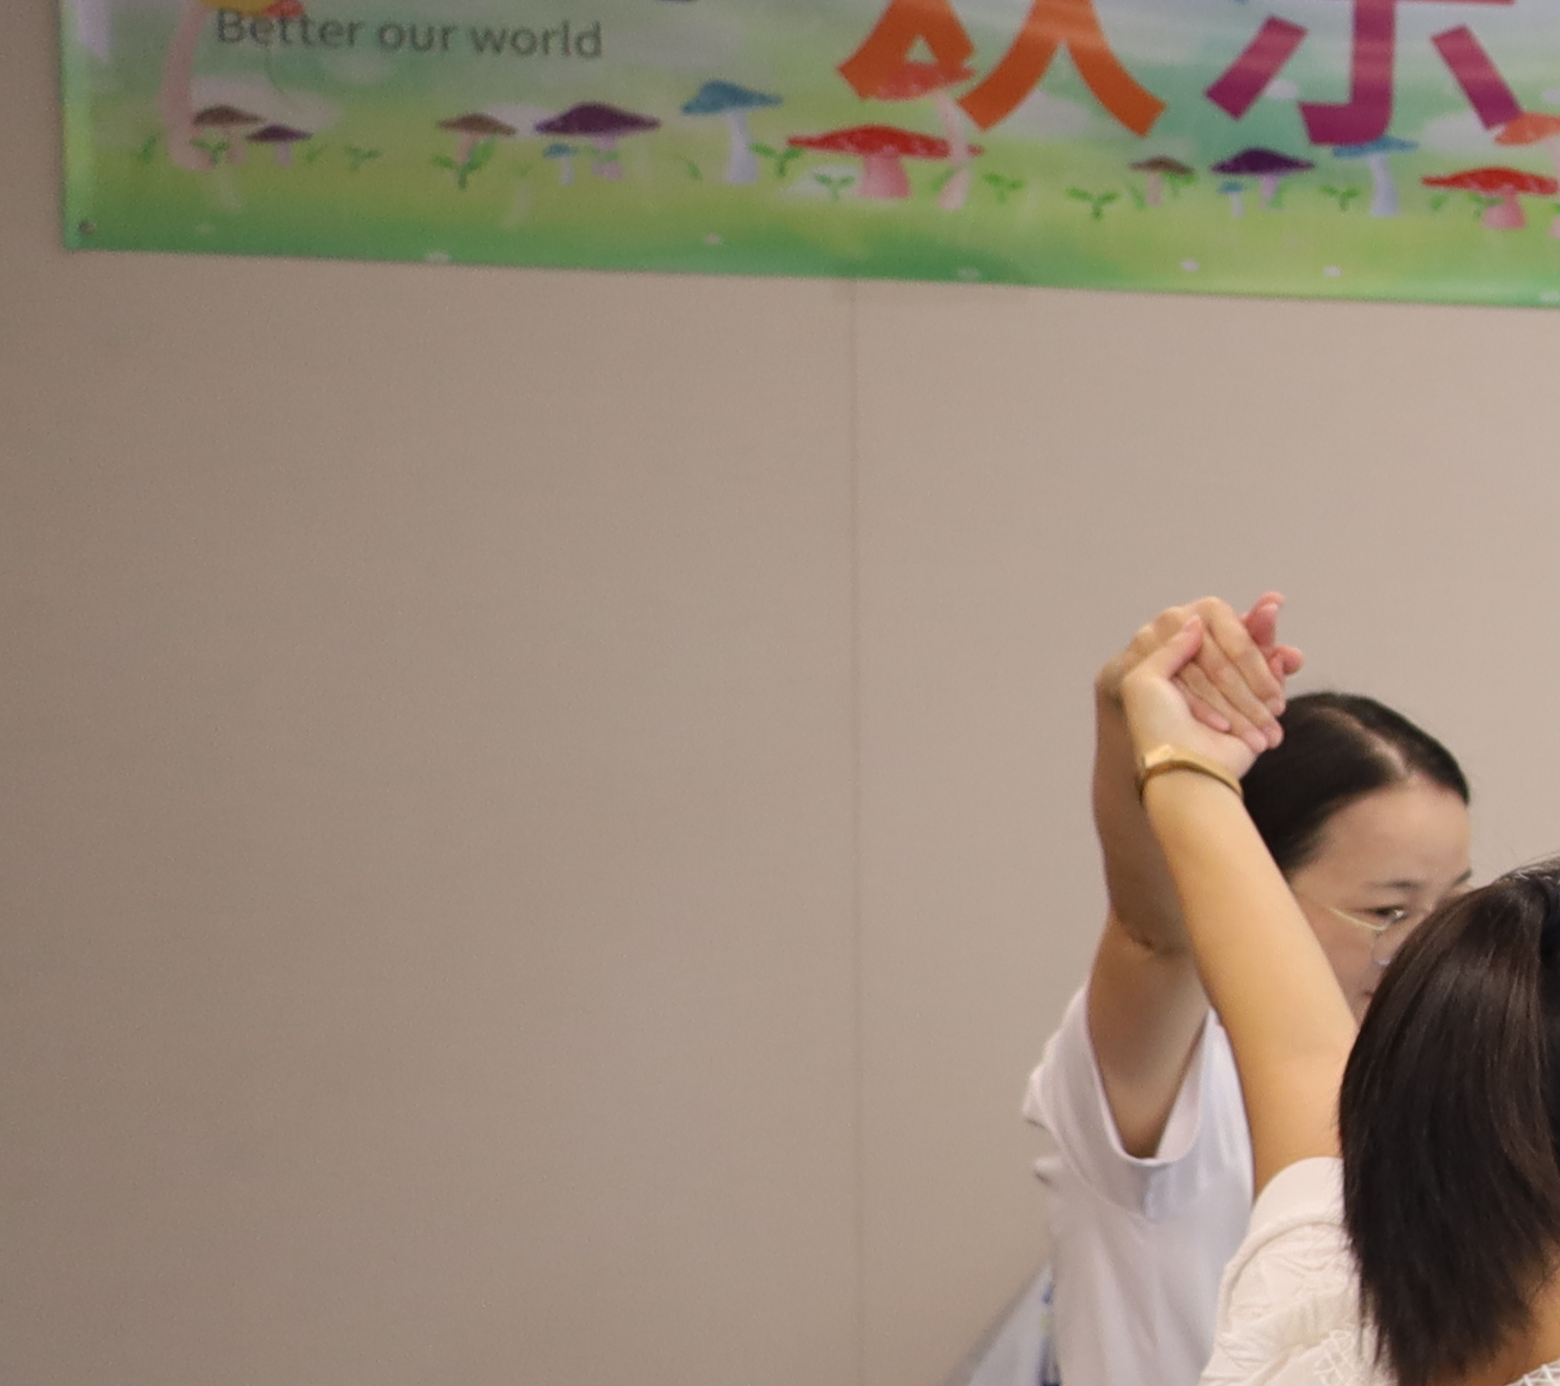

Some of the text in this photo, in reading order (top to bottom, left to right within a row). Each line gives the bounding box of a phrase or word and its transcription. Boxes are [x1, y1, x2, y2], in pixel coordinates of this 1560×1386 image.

[216, 8, 603, 60] Better our world
